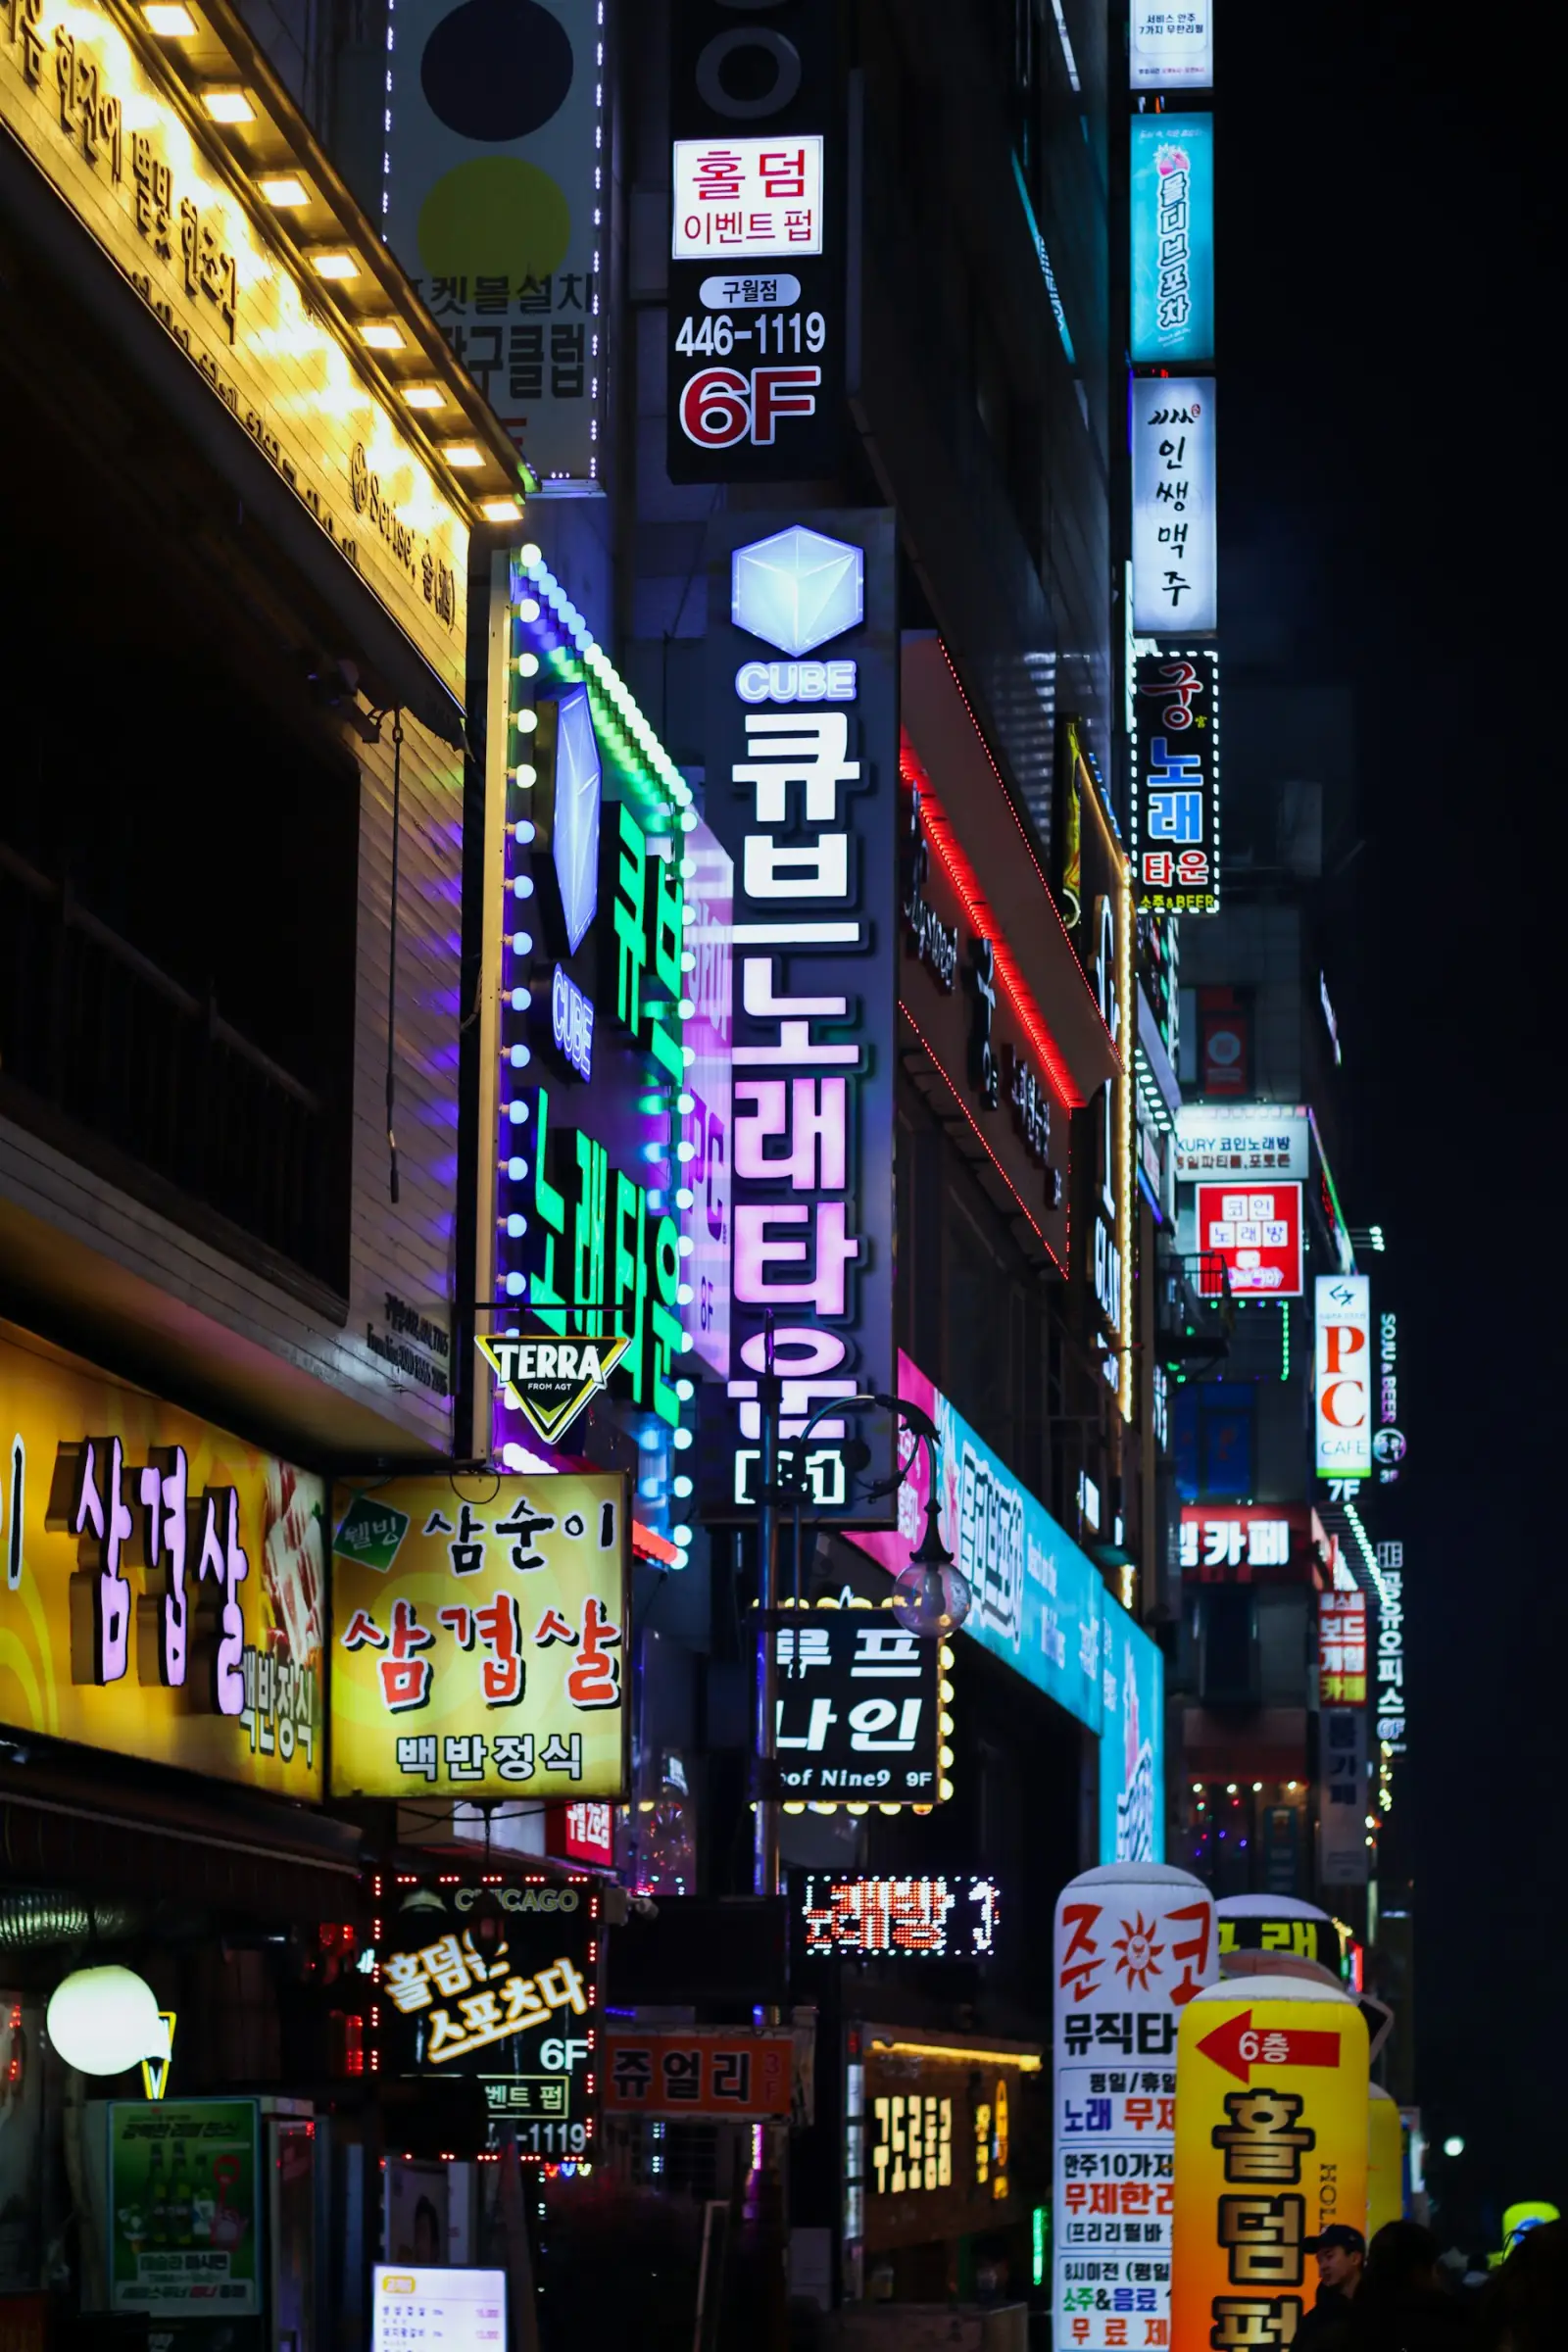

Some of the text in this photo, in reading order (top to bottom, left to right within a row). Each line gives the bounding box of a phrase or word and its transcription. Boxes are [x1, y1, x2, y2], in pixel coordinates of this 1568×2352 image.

[133, 131, 174, 261] 별빛
[693, 147, 807, 202] 홀덤
[684, 209, 812, 245] 이벤트 펍
[721, 279, 779, 305] 구월점
[674, 312, 826, 358] 446-1119
[679, 367, 822, 449] 6F
[735, 660, 858, 704] CUBE
[1142, 850, 1209, 887] 타운
[552, 960, 594, 1084] CUBE
[1219, 1136, 1291, 1152] 코인노래방
[1381, 1313, 1396, 1360] SOJU
[491, 1344, 603, 1382] TERRA
[1381, 1376, 1397, 1424] BEER
[1327, 1479, 1360, 1502] 7F
[344, 1516, 399, 1549] 웰빙
[422, 1499, 616, 1574] 삼순이
[74, 1435, 249, 1717] 삼겹살
[1320, 1616, 1365, 1642] 보드
[343, 1592, 621, 1715] 삼겹살
[238, 1643, 314, 1770] 백반정식
[775, 1697, 922, 1751] 나인
[397, 1734, 583, 1782] 백반정식
[820, 1769, 891, 1787] Nine9
[906, 1772, 932, 1787] 9F
[454, 1888, 579, 1912] CCAGO
[426, 1957, 589, 2064] 스포츠다
[539, 2038, 589, 2071] 6F
[1238, 2031, 1291, 2064] 6층
[484, 2084, 563, 2109] 벤트 펍
[612, 2049, 751, 2103] 쥬얼리
[1064, 2098, 1111, 2132] 노래
[485, 2123, 587, 2153] -1119
[1319, 2163, 1337, 2234] HOL
[1063, 2287, 1157, 2312] 소주&음료
